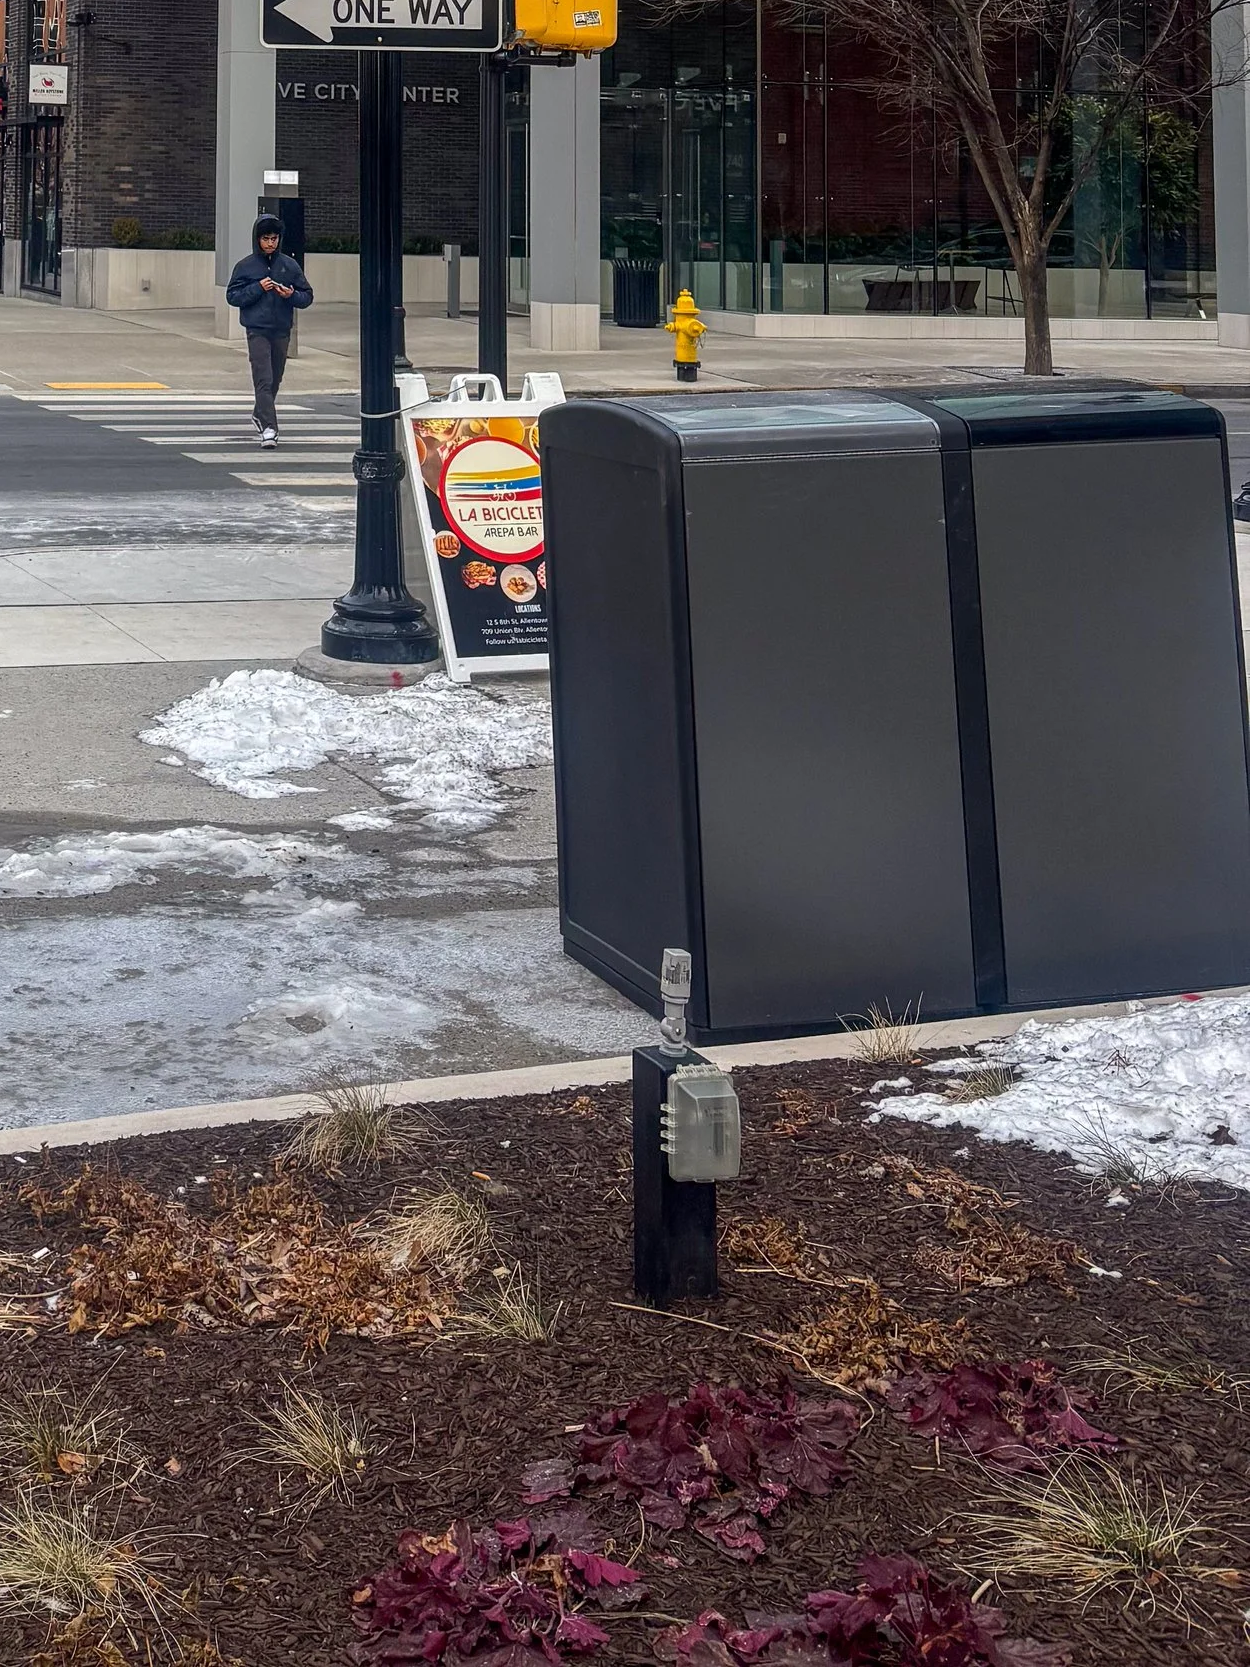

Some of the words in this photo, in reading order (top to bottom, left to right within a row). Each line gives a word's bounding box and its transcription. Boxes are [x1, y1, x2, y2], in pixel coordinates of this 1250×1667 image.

[278, 82, 306, 99] VE
[402, 86, 460, 104] NTER
[458, 508, 477, 522] LA
[482, 506, 542, 521] BICICLET
[484, 527, 514, 538] AREPA
[517, 527, 539, 537] BAR
